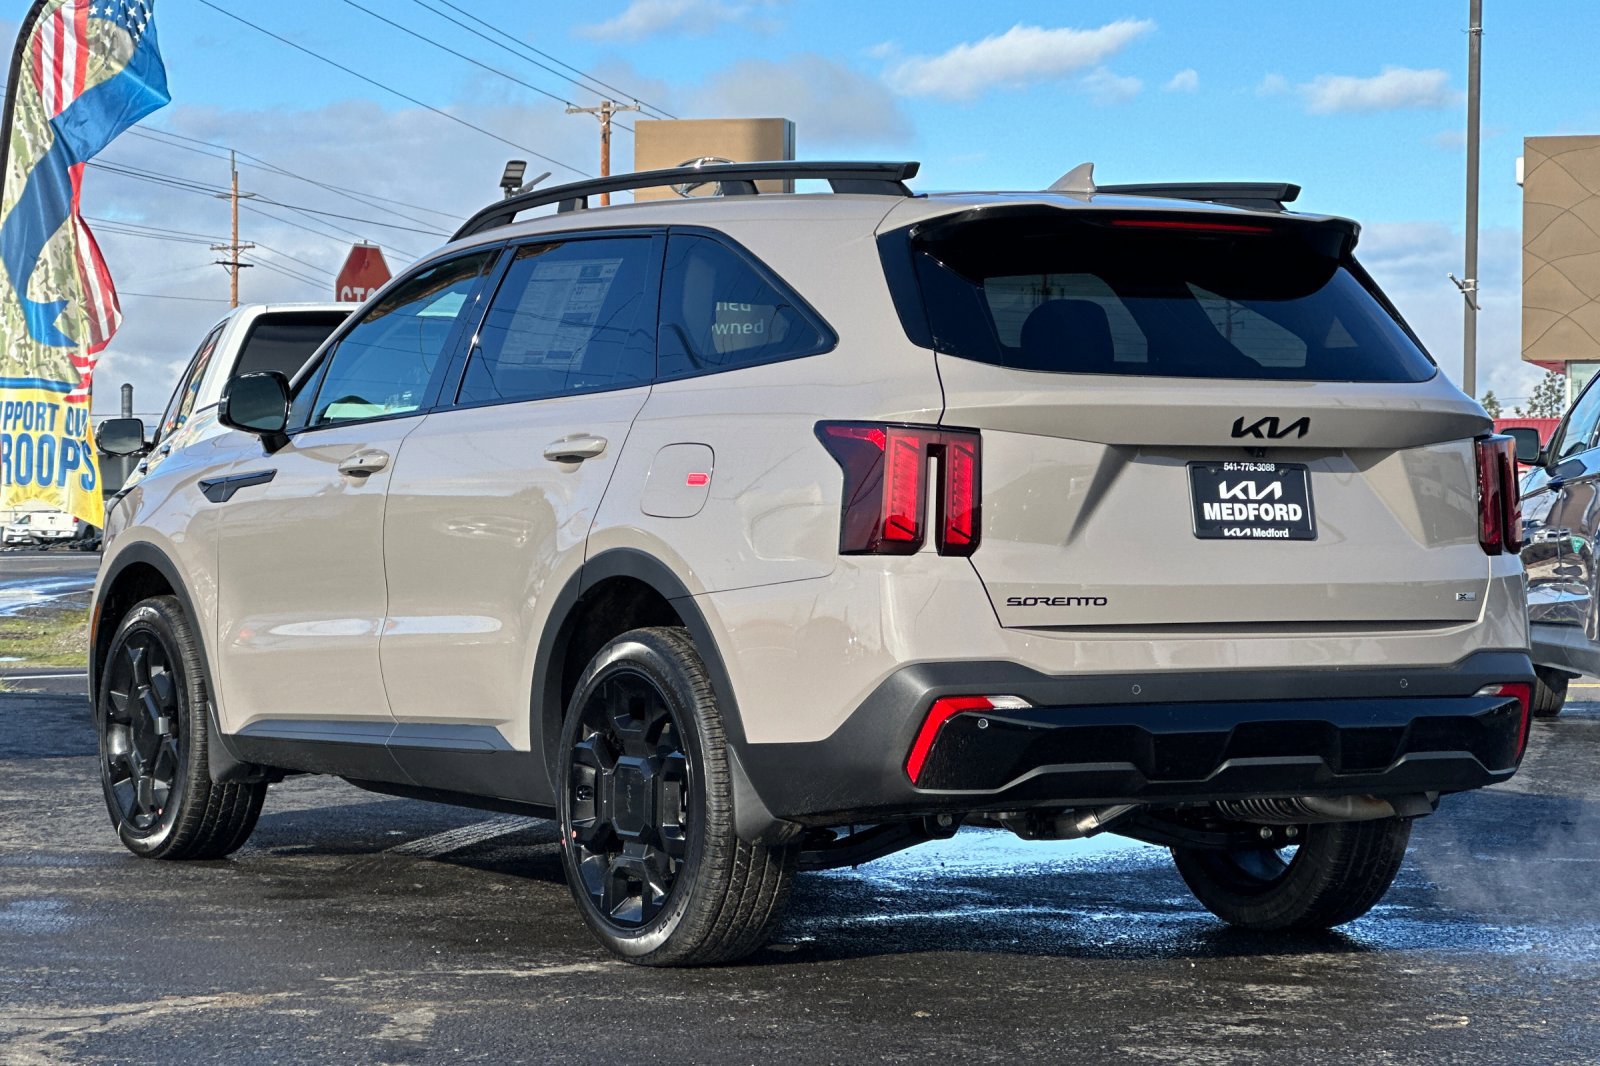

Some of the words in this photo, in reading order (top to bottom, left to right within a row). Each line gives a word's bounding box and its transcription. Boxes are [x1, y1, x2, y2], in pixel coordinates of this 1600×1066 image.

[712, 318, 764, 334] wned
[0, 400, 60, 432] PPORT
[65, 406, 88, 437] OU
[1231, 416, 1311, 439] KIA
[1223, 461, 1276, 472] 541-776-3088
[1218, 480, 1283, 500] KIA
[1203, 502, 1303, 521] MEDFORD
[1224, 527, 1251, 537] KIA
[1252, 527, 1289, 538] Medford
[1006, 597, 1108, 606] SORENTO
